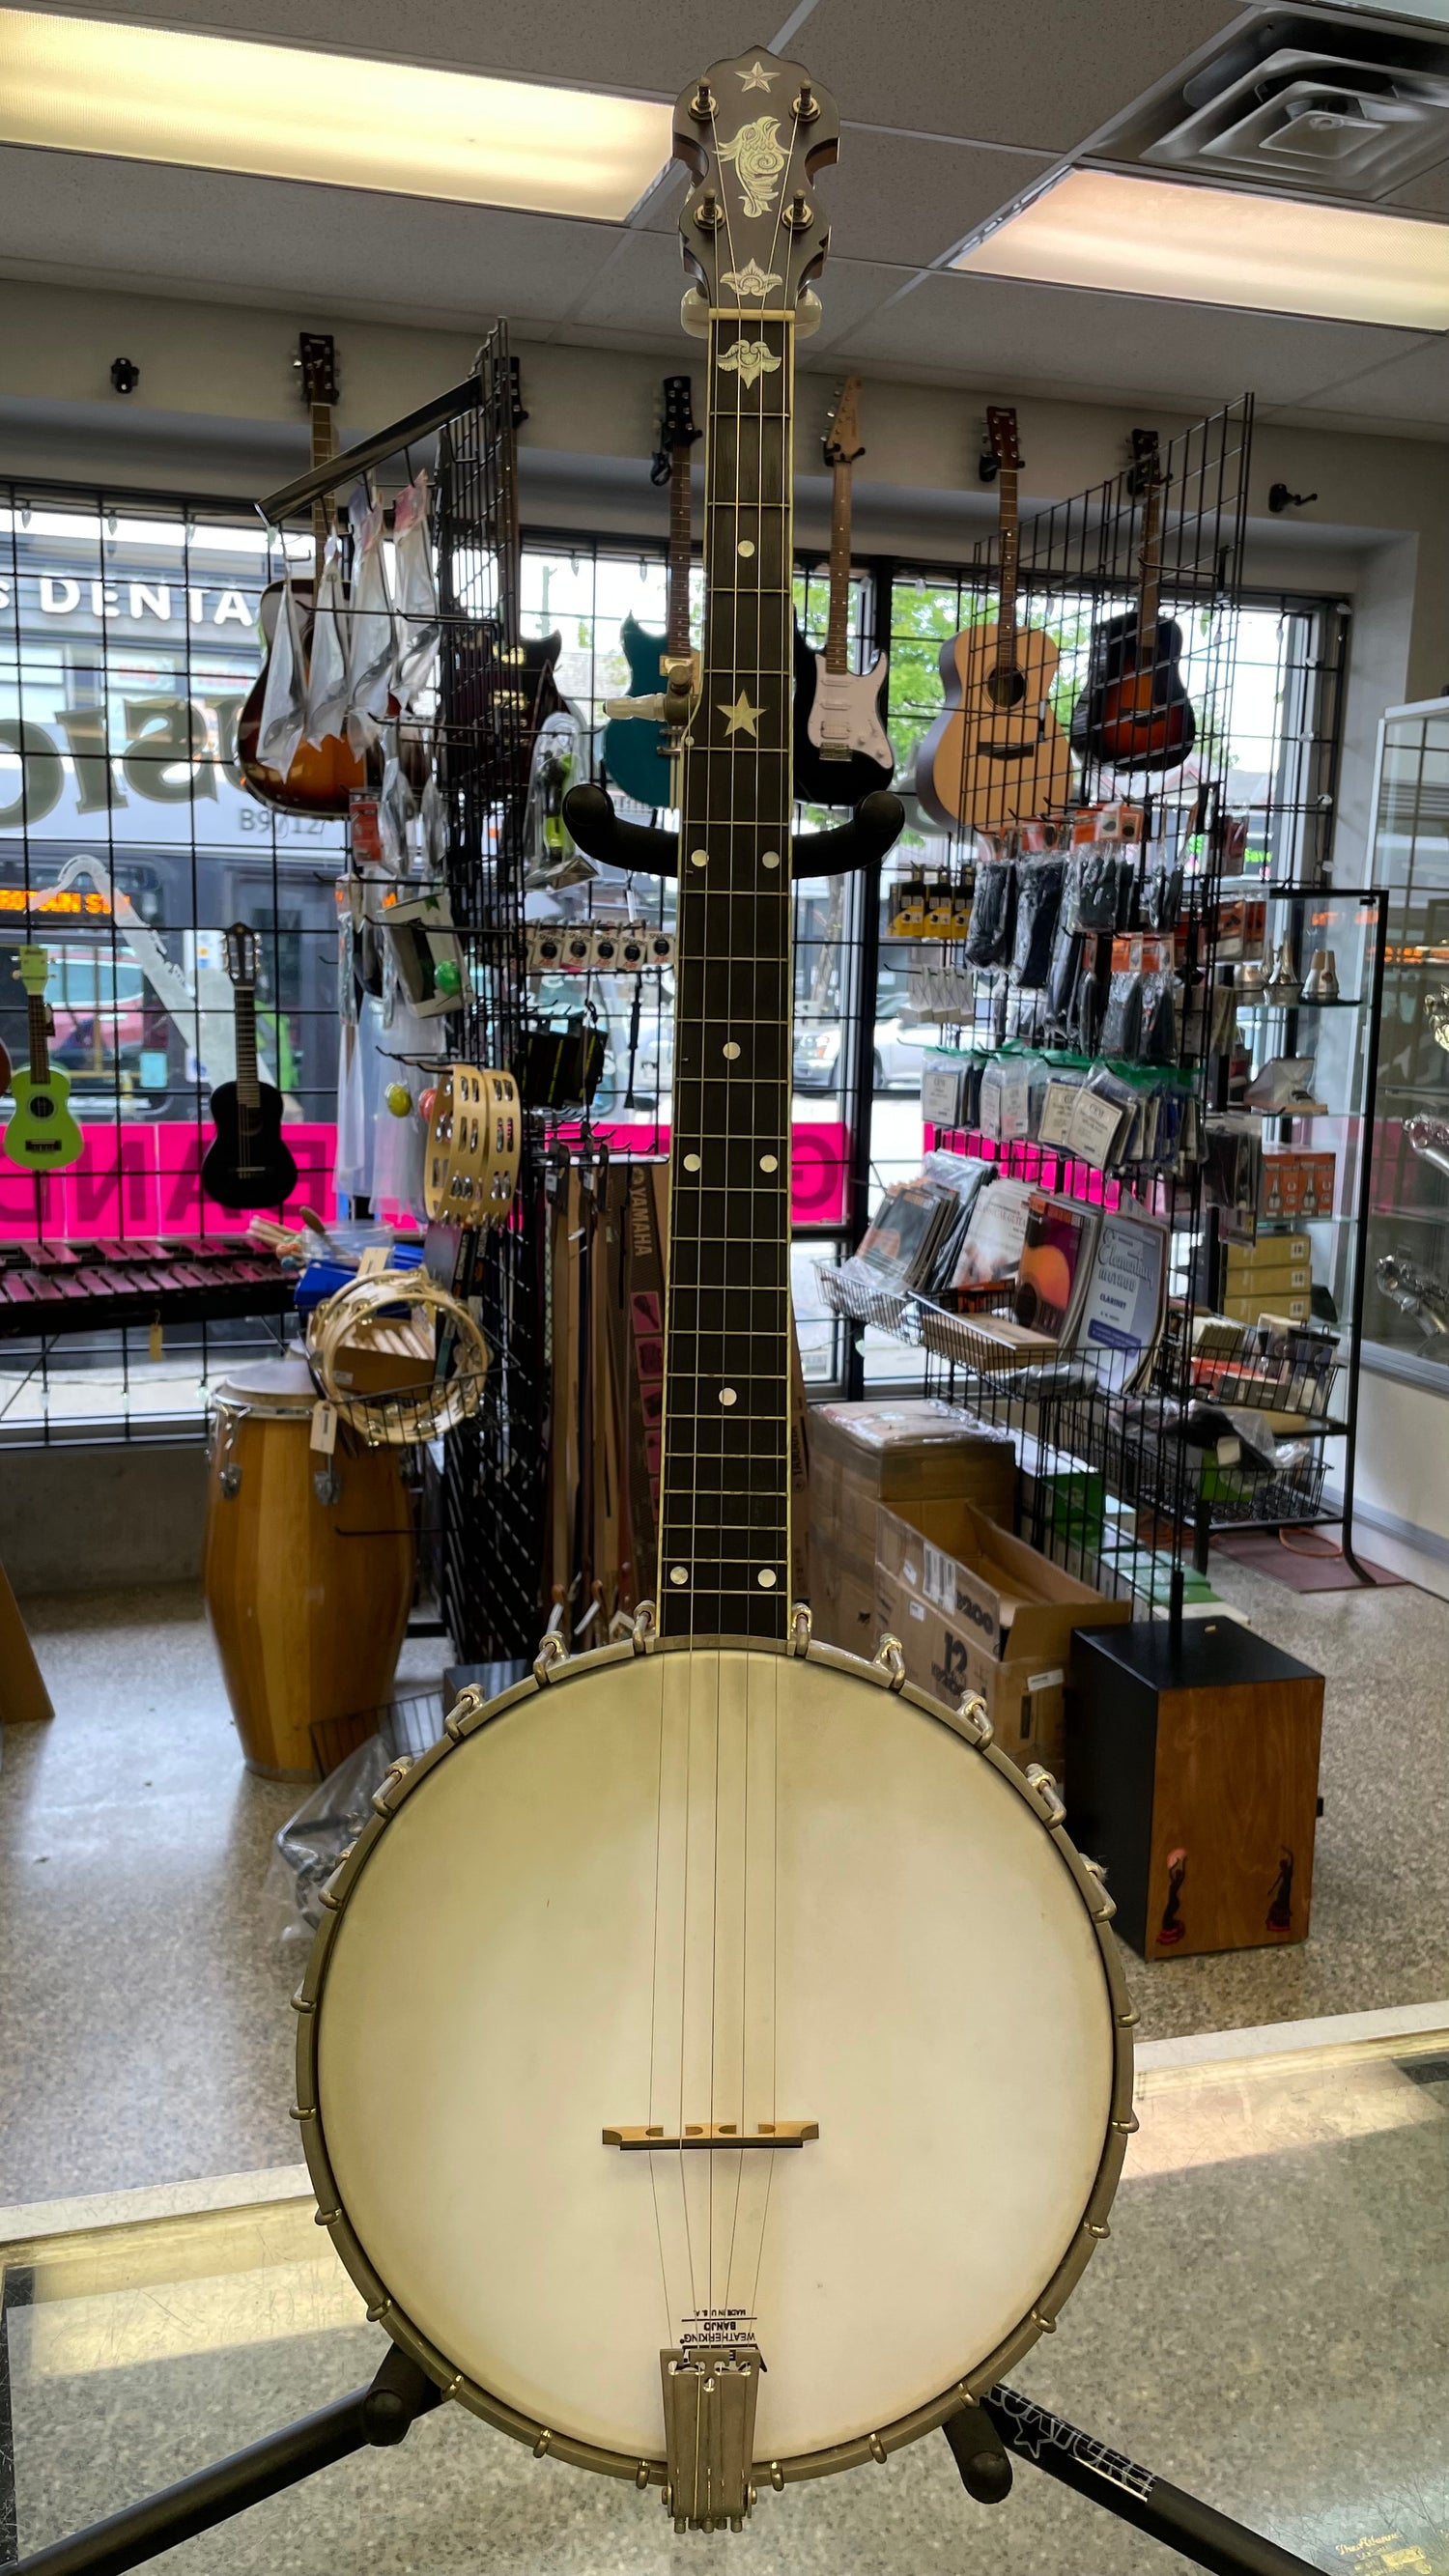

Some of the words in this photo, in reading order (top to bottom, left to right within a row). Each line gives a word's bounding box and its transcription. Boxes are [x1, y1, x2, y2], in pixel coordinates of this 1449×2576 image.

[40, 578, 253, 627] DENTA
[629, 1187, 653, 1257] YAMAHA
[703, 2321, 736, 2331] BANJO
